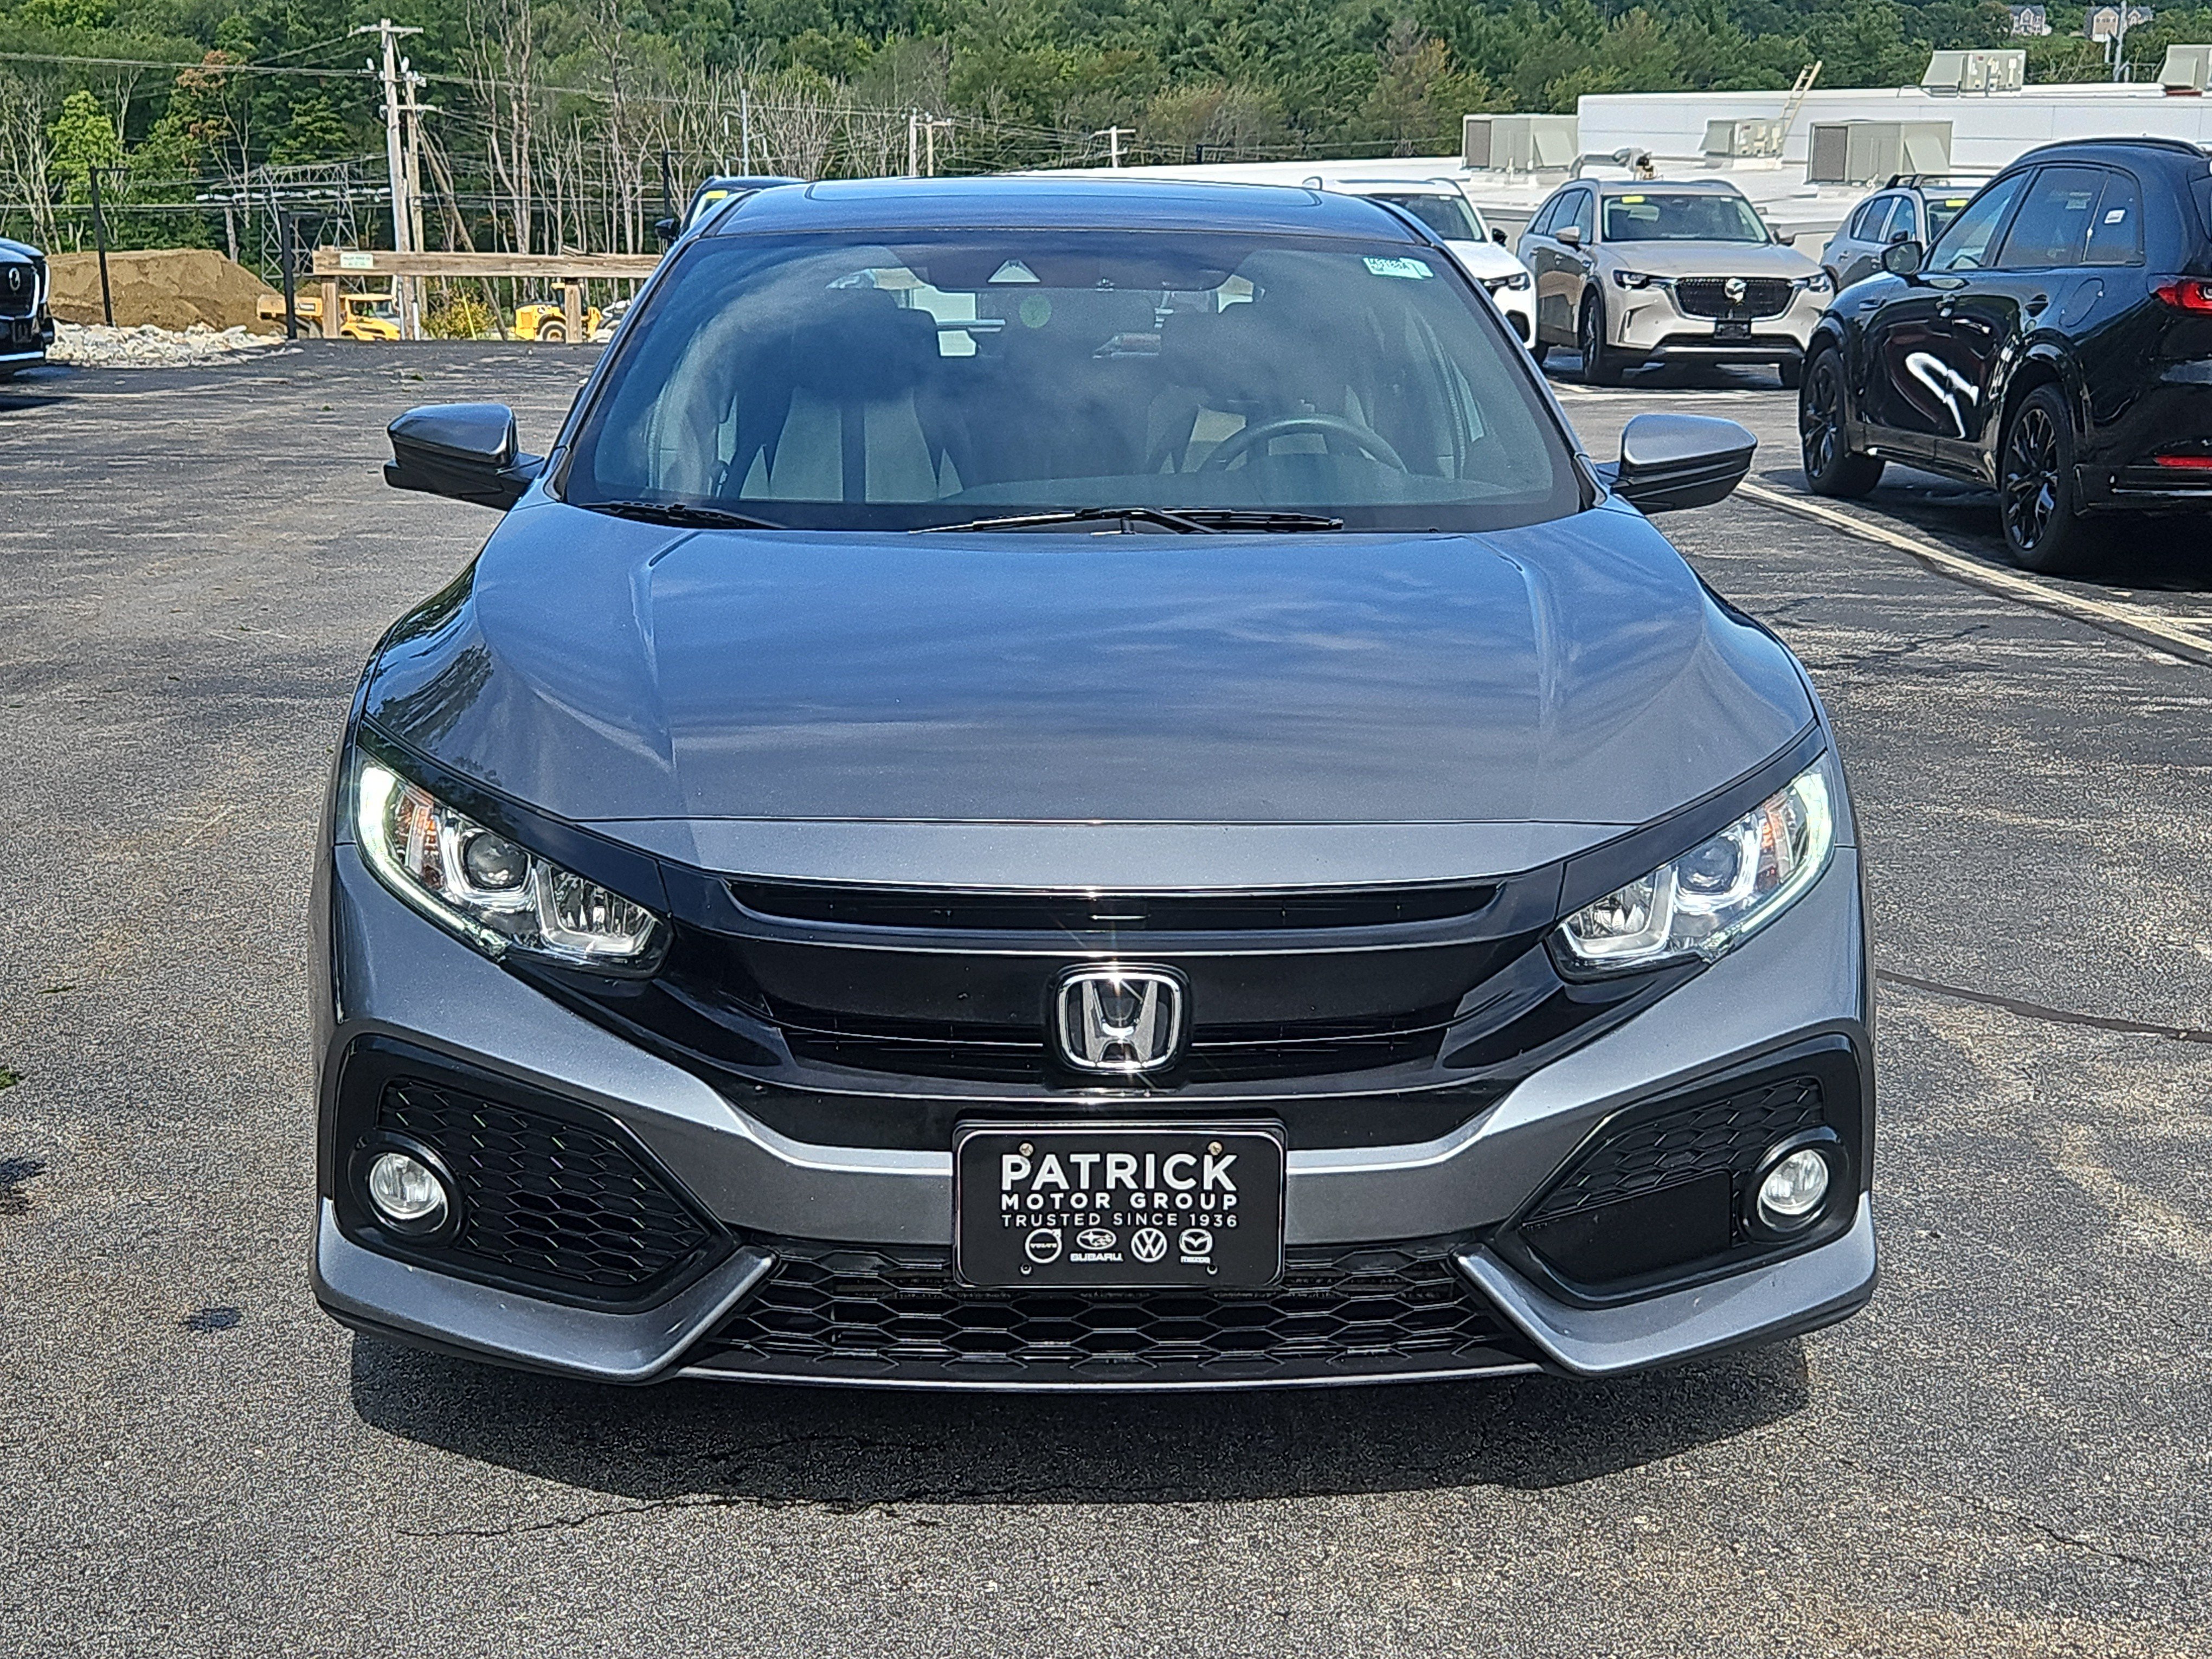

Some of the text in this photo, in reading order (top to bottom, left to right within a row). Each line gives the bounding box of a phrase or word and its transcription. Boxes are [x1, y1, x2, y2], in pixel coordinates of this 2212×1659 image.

[1001, 1154, 1237, 1191] PATRICK
[1002, 1193, 1236, 1210] MOTOR GROUP
[1002, 1213, 1236, 1227] TRUSTED SINCE 1936
